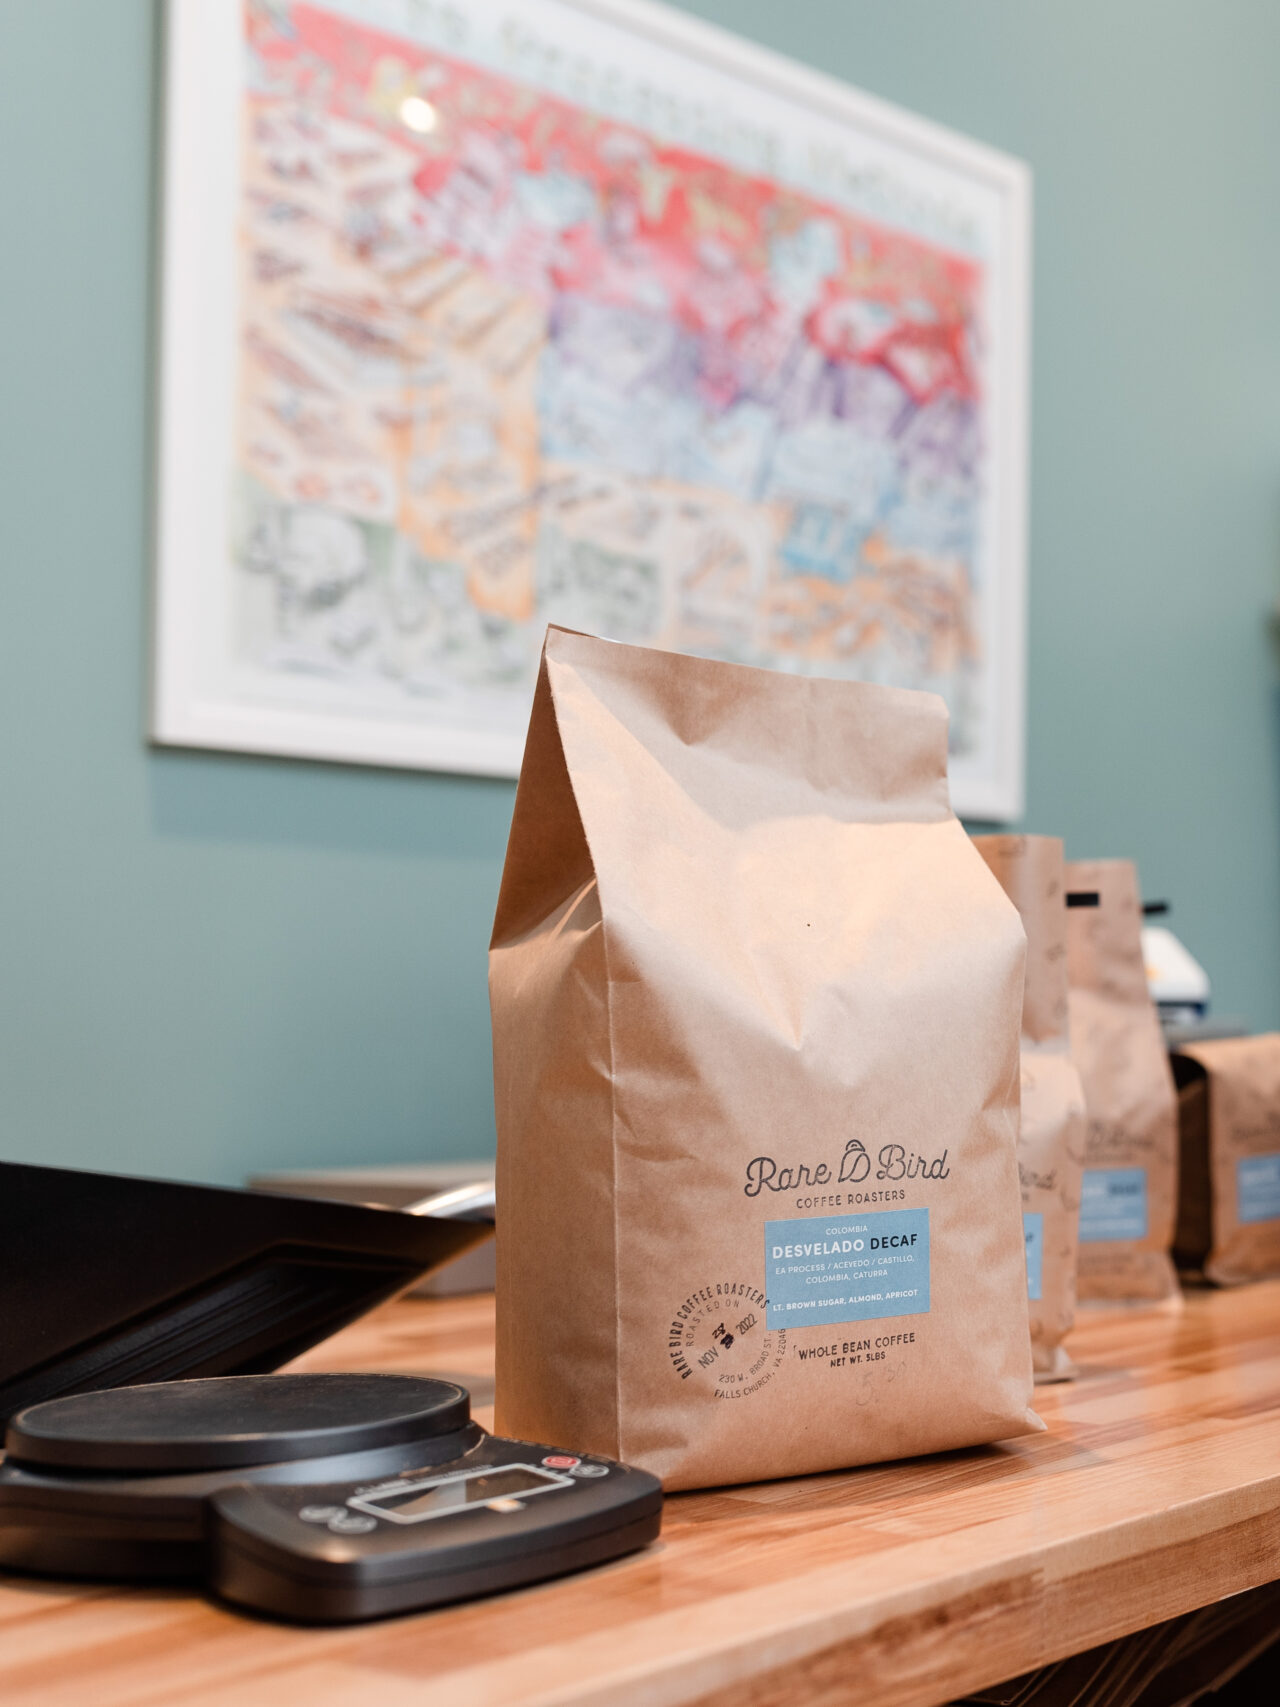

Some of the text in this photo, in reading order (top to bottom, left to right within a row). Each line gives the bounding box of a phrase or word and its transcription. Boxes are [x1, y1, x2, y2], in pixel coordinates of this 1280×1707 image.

[744, 1144, 950, 1197] Rare Bird
[796, 1189, 905, 1209] COFFEE ROASTERS
[825, 1225, 868, 1236] COLOMBIA
[772, 1233, 918, 1259] DESVELADO DECAF
[775, 1267, 786, 1275] EA
[788, 1263, 825, 1274] PROCESS
[833, 1259, 870, 1270] ACEVEDO
[878, 1254, 915, 1265] CASTILLO,
[805, 1269, 888, 1284] COLOMBIA, CATURRA
[676, 1286, 713, 1320] COFFEE
[717, 1282, 770, 1309] ROASTERS
[773, 1289, 918, 1312] LT. BROWN SUGAR, ALMOND, APRICOT
[669, 1321, 684, 1347] BIRD
[686, 1300, 720, 1347] ROASTED
[725, 1299, 740, 1308] ON
[697, 1313, 758, 1369] NOV 2022
[798, 1332, 916, 1361] WHOLE BEAN COFFEE
[670, 1350, 693, 1380] RARE
[718, 1374, 735, 1384] 230
[749, 1351, 769, 1376] BROAD
[830, 1351, 886, 1368] NET WT. 5LBS
[714, 1389, 741, 1399] FALLS
[772, 1357, 783, 1368] VA
